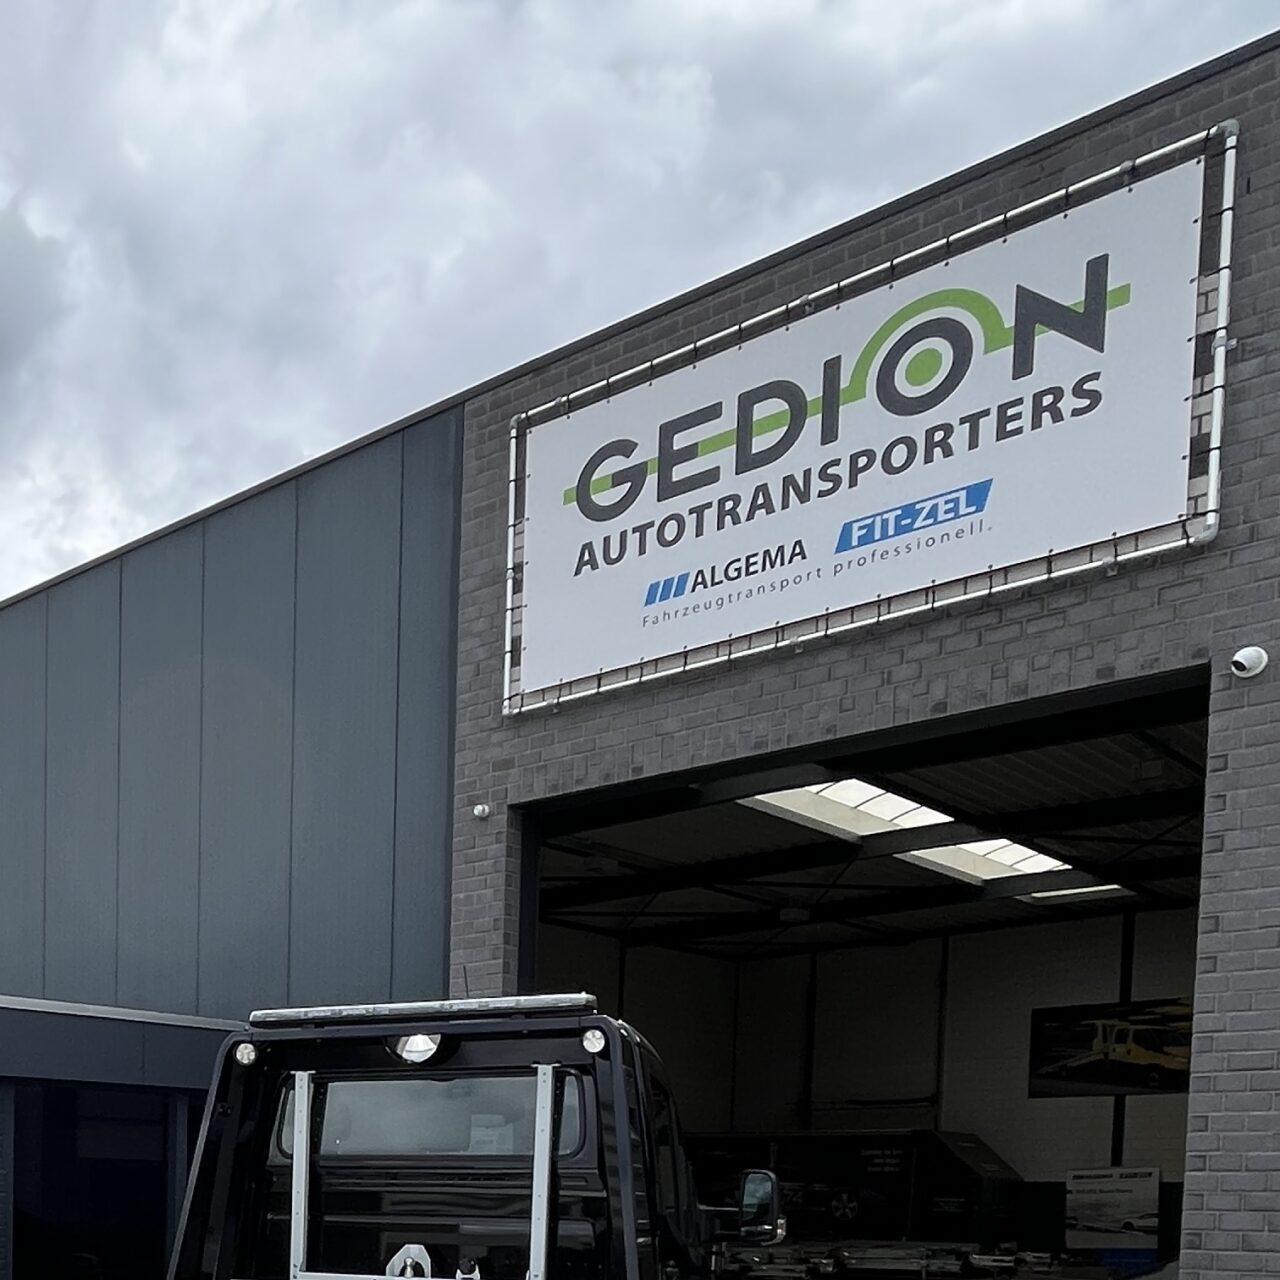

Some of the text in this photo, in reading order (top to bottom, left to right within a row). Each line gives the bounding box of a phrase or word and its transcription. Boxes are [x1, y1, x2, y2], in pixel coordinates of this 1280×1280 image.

[576, 253, 1109, 521] GEDION
[573, 370, 1104, 577] AUTOTRANSPORTERS
[690, 487, 979, 593] ALGEMA FIT-ZEL
[642, 518, 994, 628] Fahrzeugtransport professionell.
